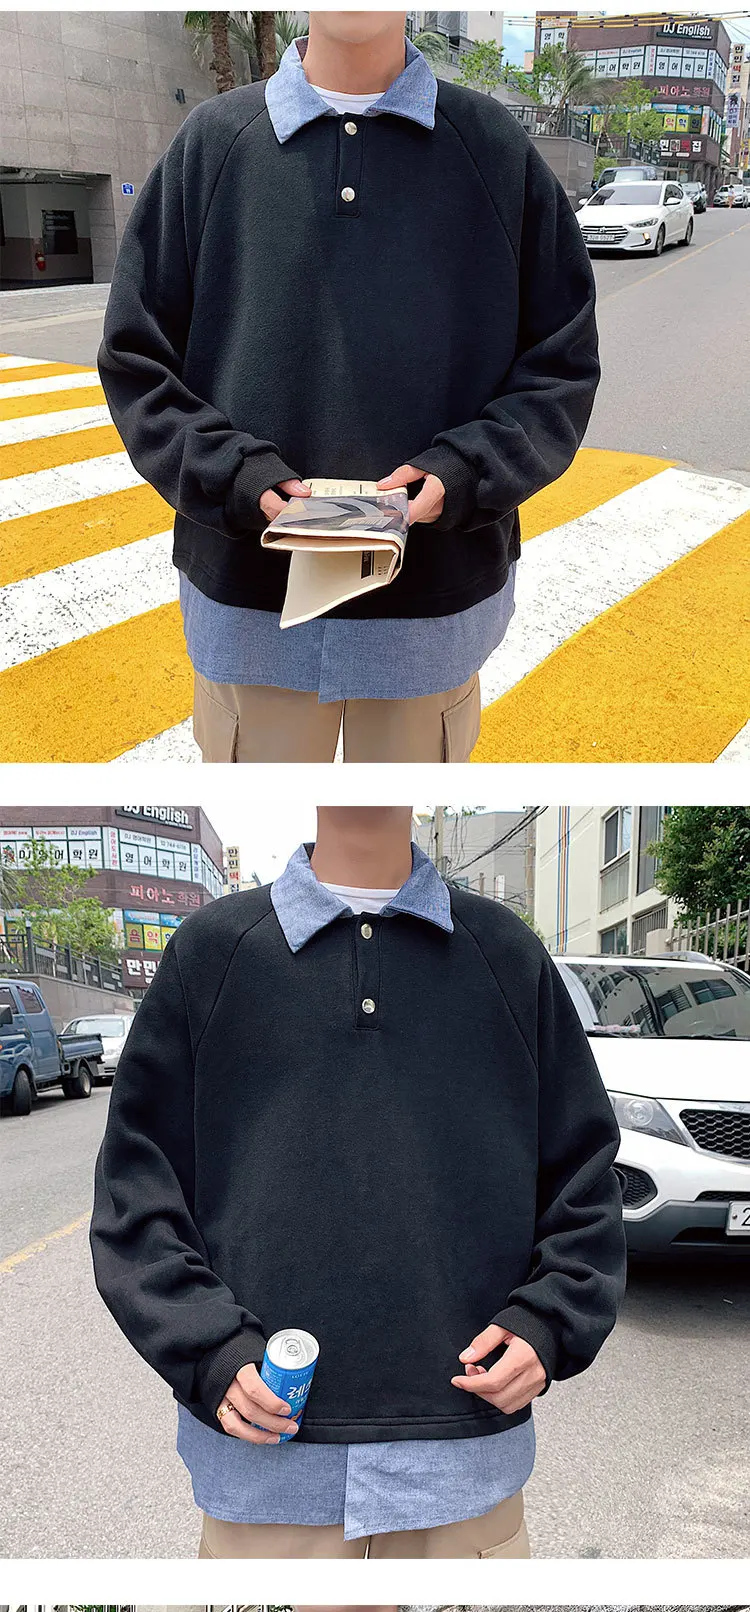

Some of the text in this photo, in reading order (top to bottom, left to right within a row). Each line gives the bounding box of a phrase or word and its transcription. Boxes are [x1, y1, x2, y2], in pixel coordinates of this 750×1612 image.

[663, 24, 710, 36] DJ English
[657, 85, 711, 97] 피아노 학원
[143, 806, 189, 825] English
[129, 884, 201, 907] 피아노 학원
